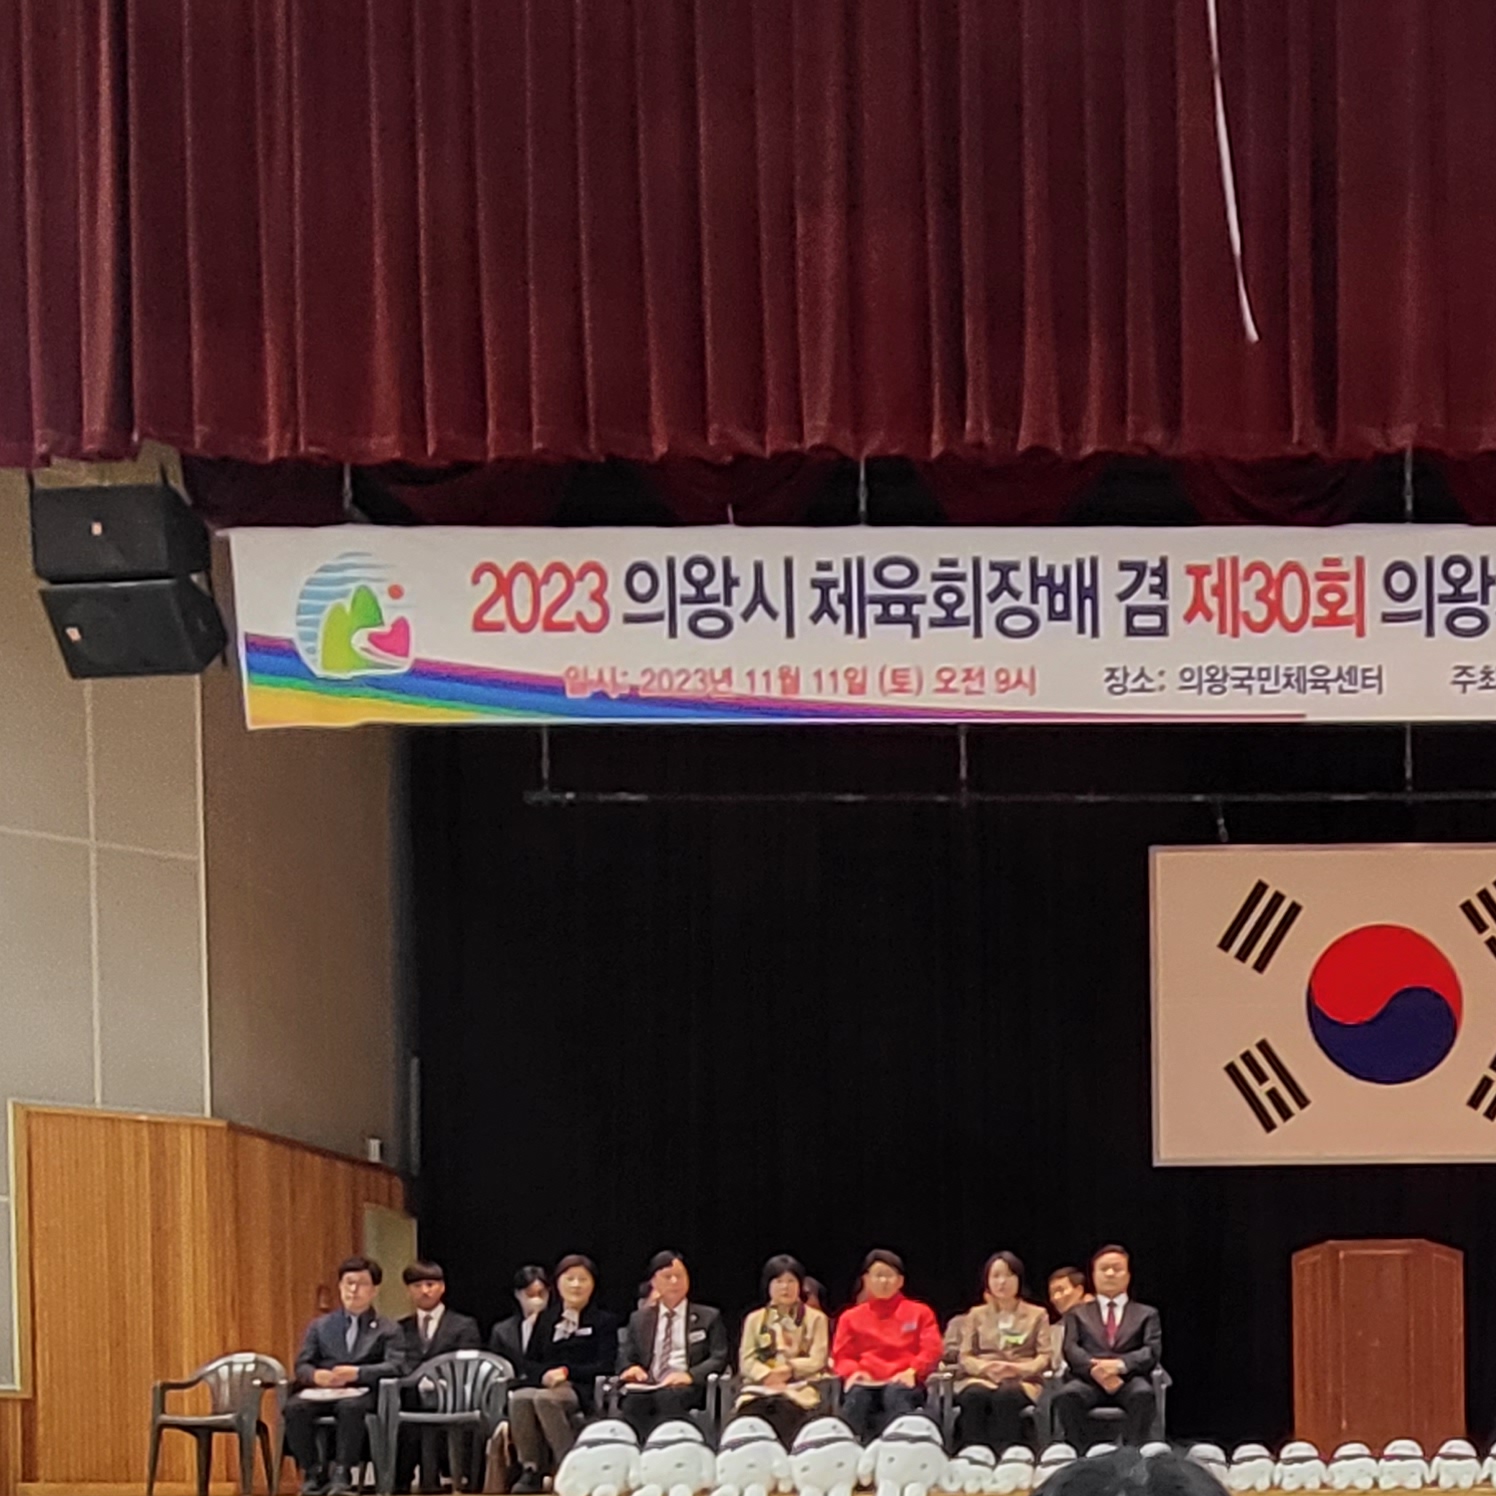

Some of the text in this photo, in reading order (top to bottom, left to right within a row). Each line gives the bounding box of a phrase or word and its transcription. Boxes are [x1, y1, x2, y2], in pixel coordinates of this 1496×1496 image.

[471, 560, 611, 635] 2023
[622, 555, 795, 639] 의왕시
[809, 555, 1100, 639] 체육회장배
[1115, 555, 1169, 638] 겸
[1183, 556, 1367, 639] 제30회
[640, 665, 733, 692] 2023년
[745, 664, 800, 696] 11월
[813, 666, 869, 697] 11일
[878, 667, 924, 697] (토)
[934, 667, 987, 697] 오전
[994, 667, 1037, 697] 9시
[1104, 664, 1383, 696] 장소: 의왕국민체육센터
